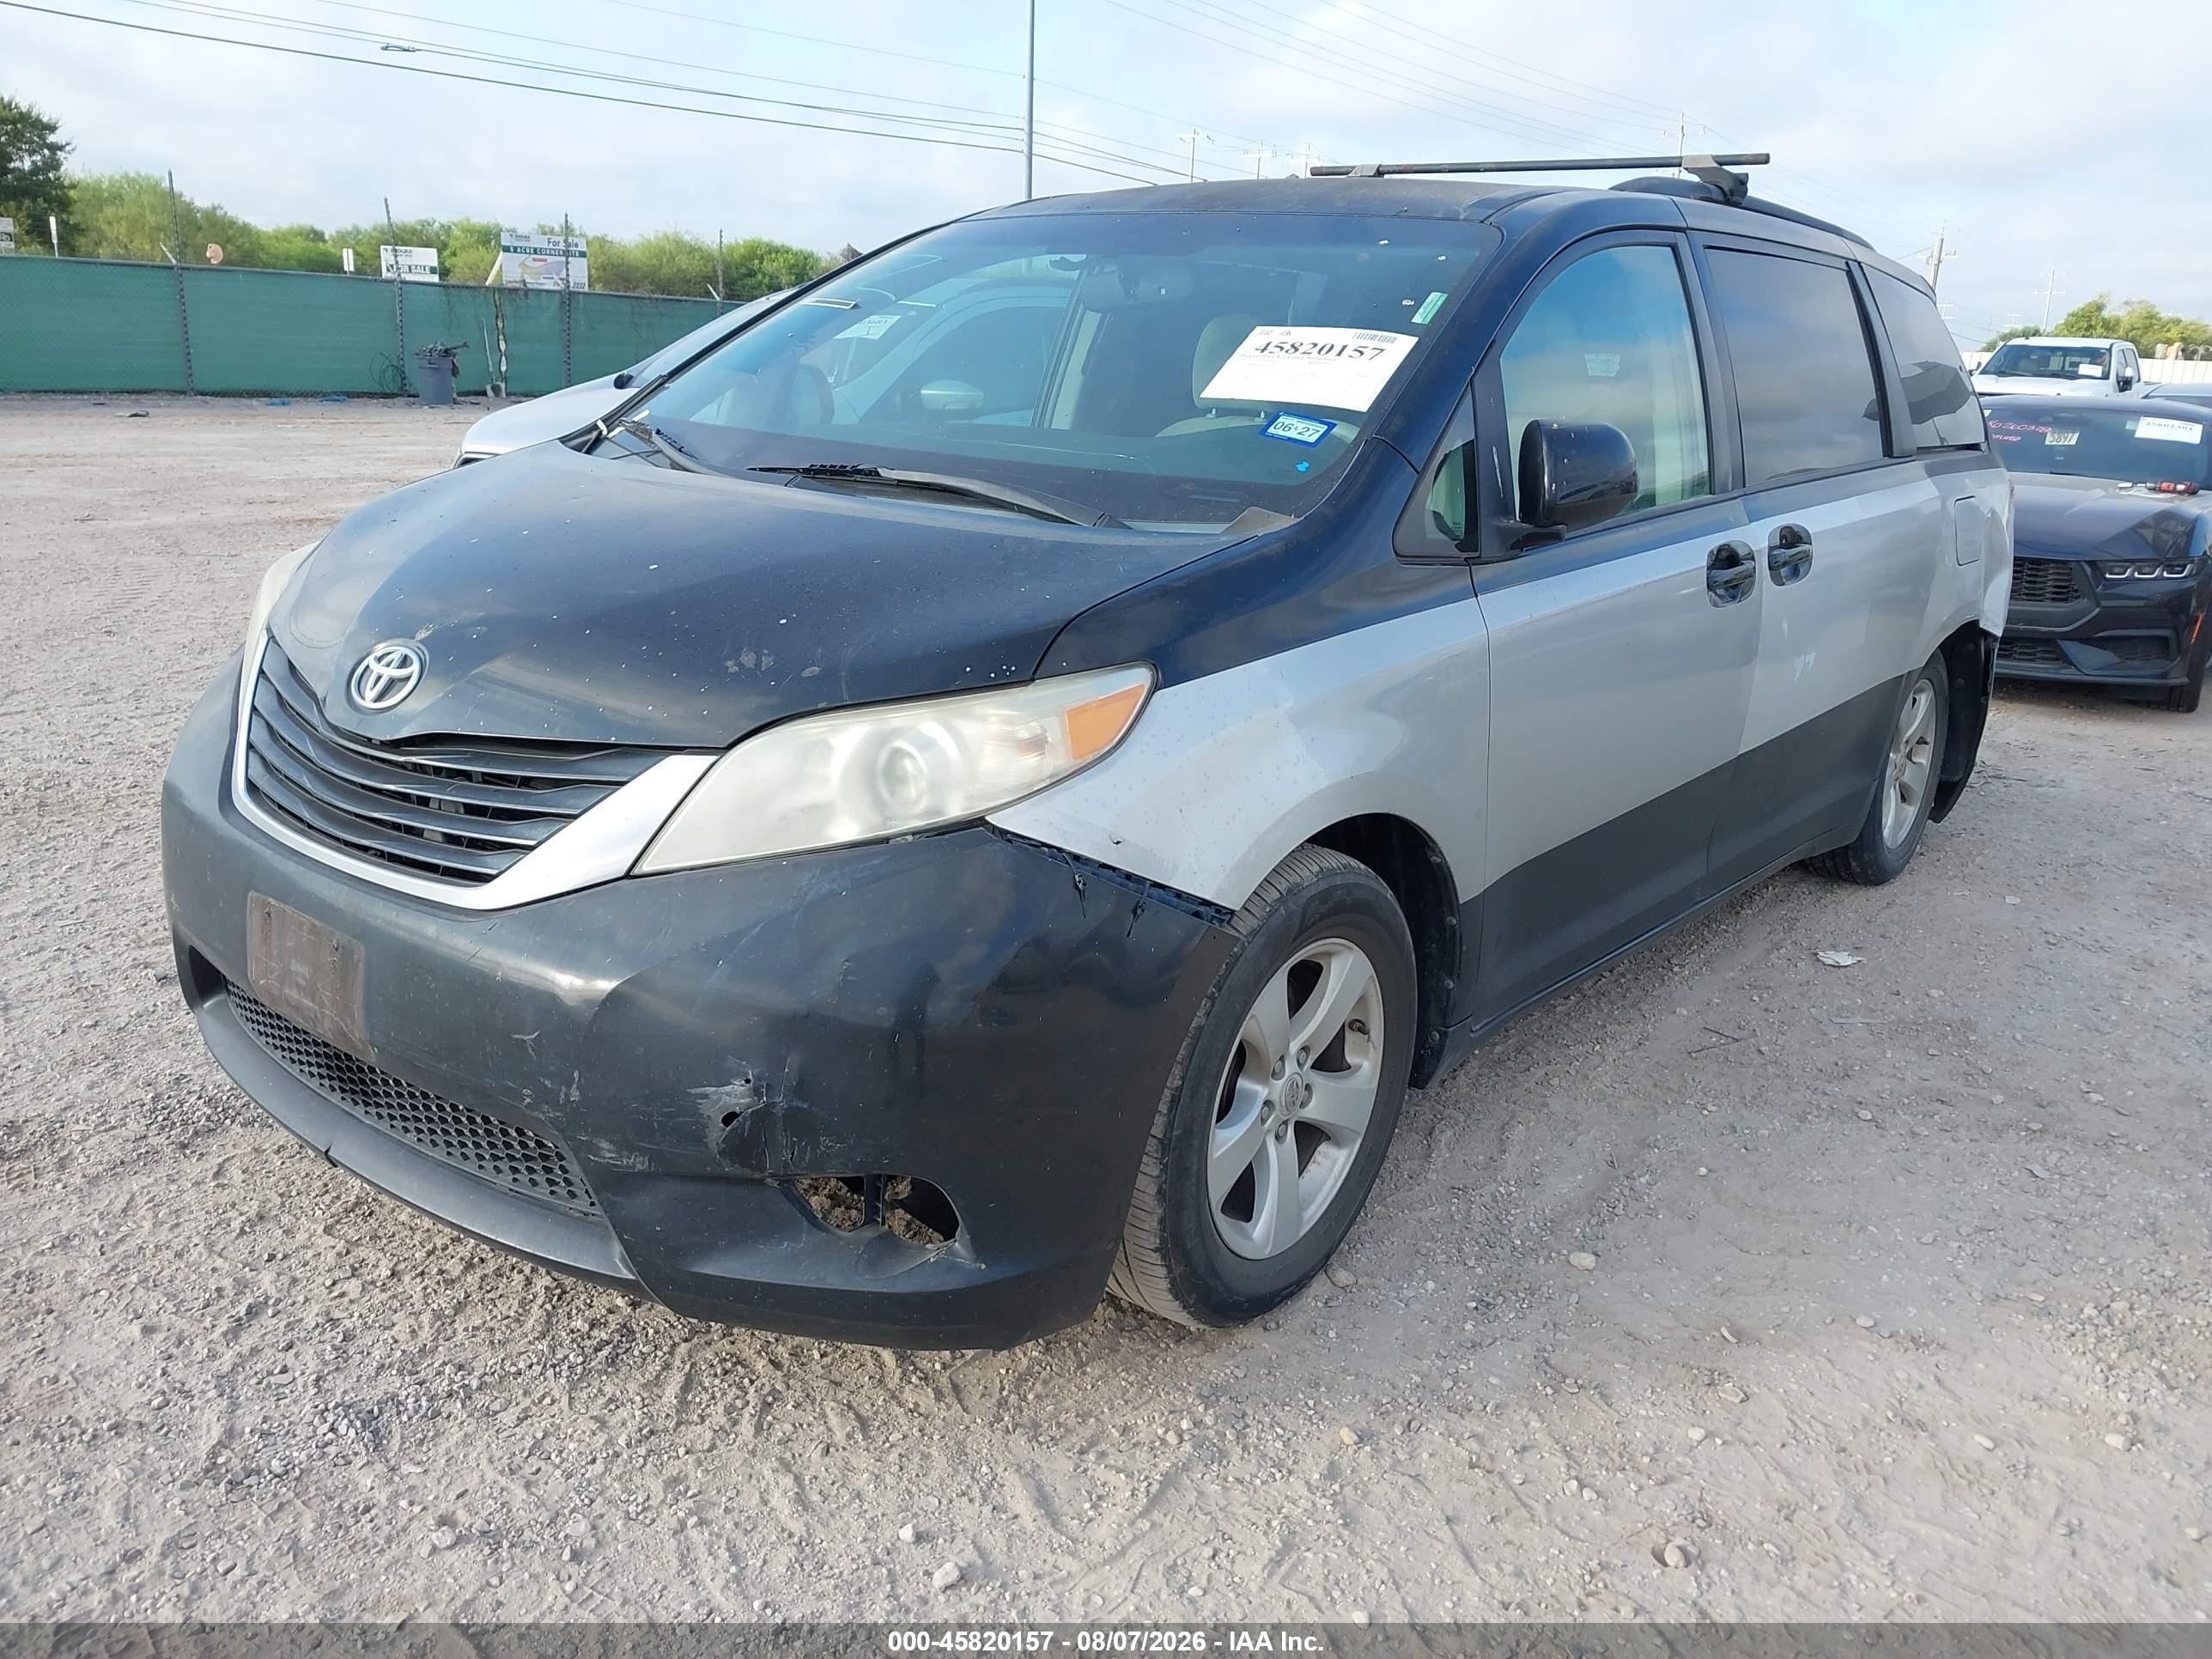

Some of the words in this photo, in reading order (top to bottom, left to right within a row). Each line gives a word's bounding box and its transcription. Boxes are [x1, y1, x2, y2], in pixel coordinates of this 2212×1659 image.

[546, 237, 561, 248] For
[410, 265, 431, 274] SALE
[1254, 340, 1387, 361] 45820157
[2048, 432, 2075, 443] 5897
